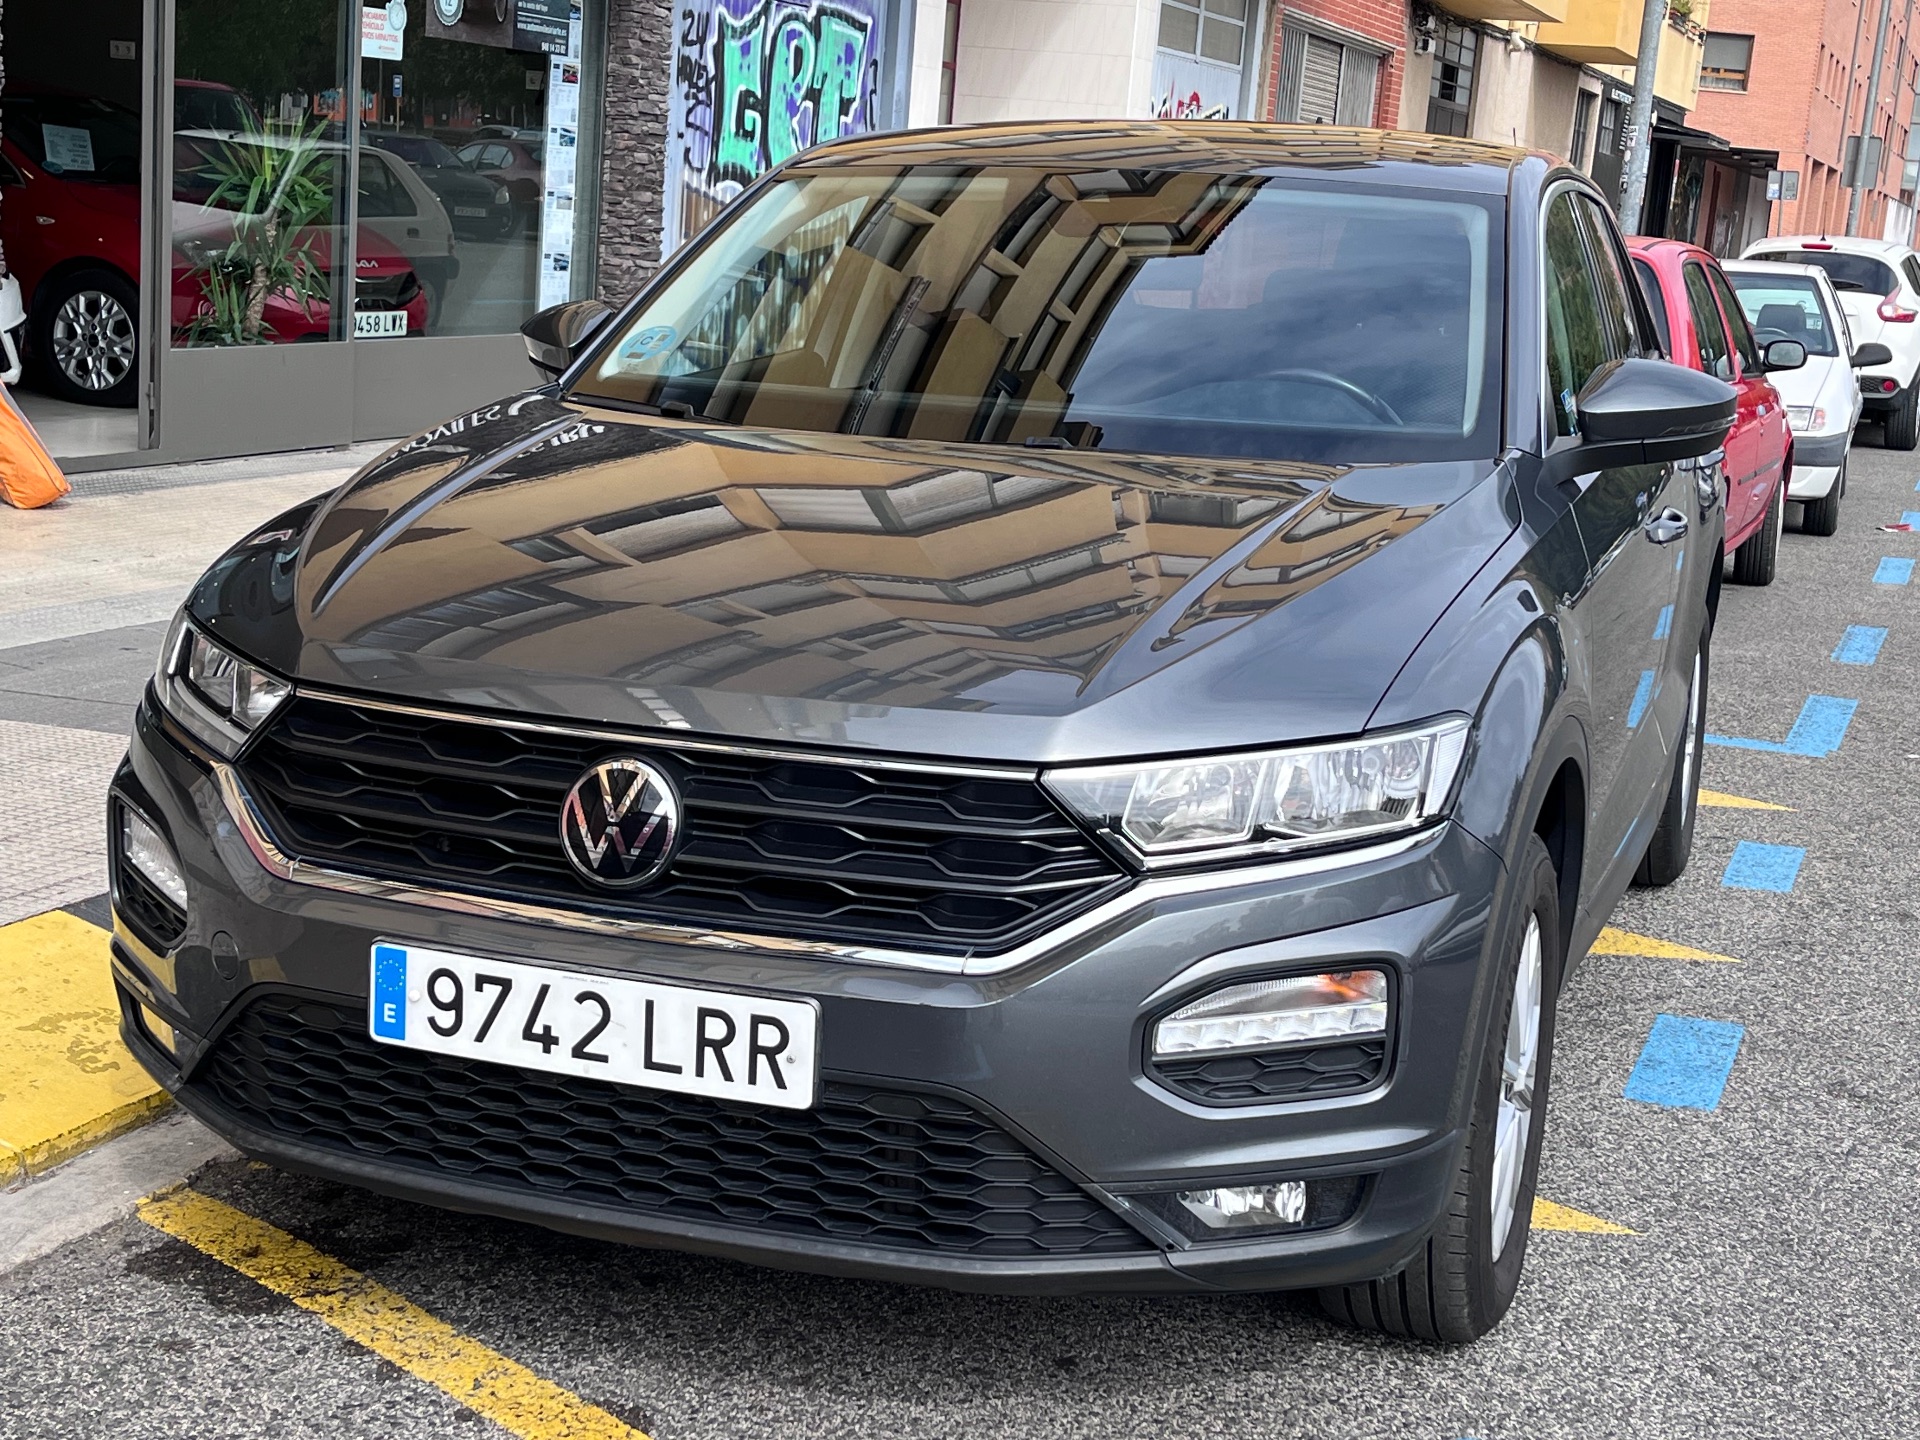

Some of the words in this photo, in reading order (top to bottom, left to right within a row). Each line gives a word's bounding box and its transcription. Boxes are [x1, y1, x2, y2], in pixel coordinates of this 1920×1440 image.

[384, 313, 404, 332] LWX
[383, 1002, 398, 1024] E
[426, 966, 611, 1064] 9742
[643, 997, 790, 1092] LRR
